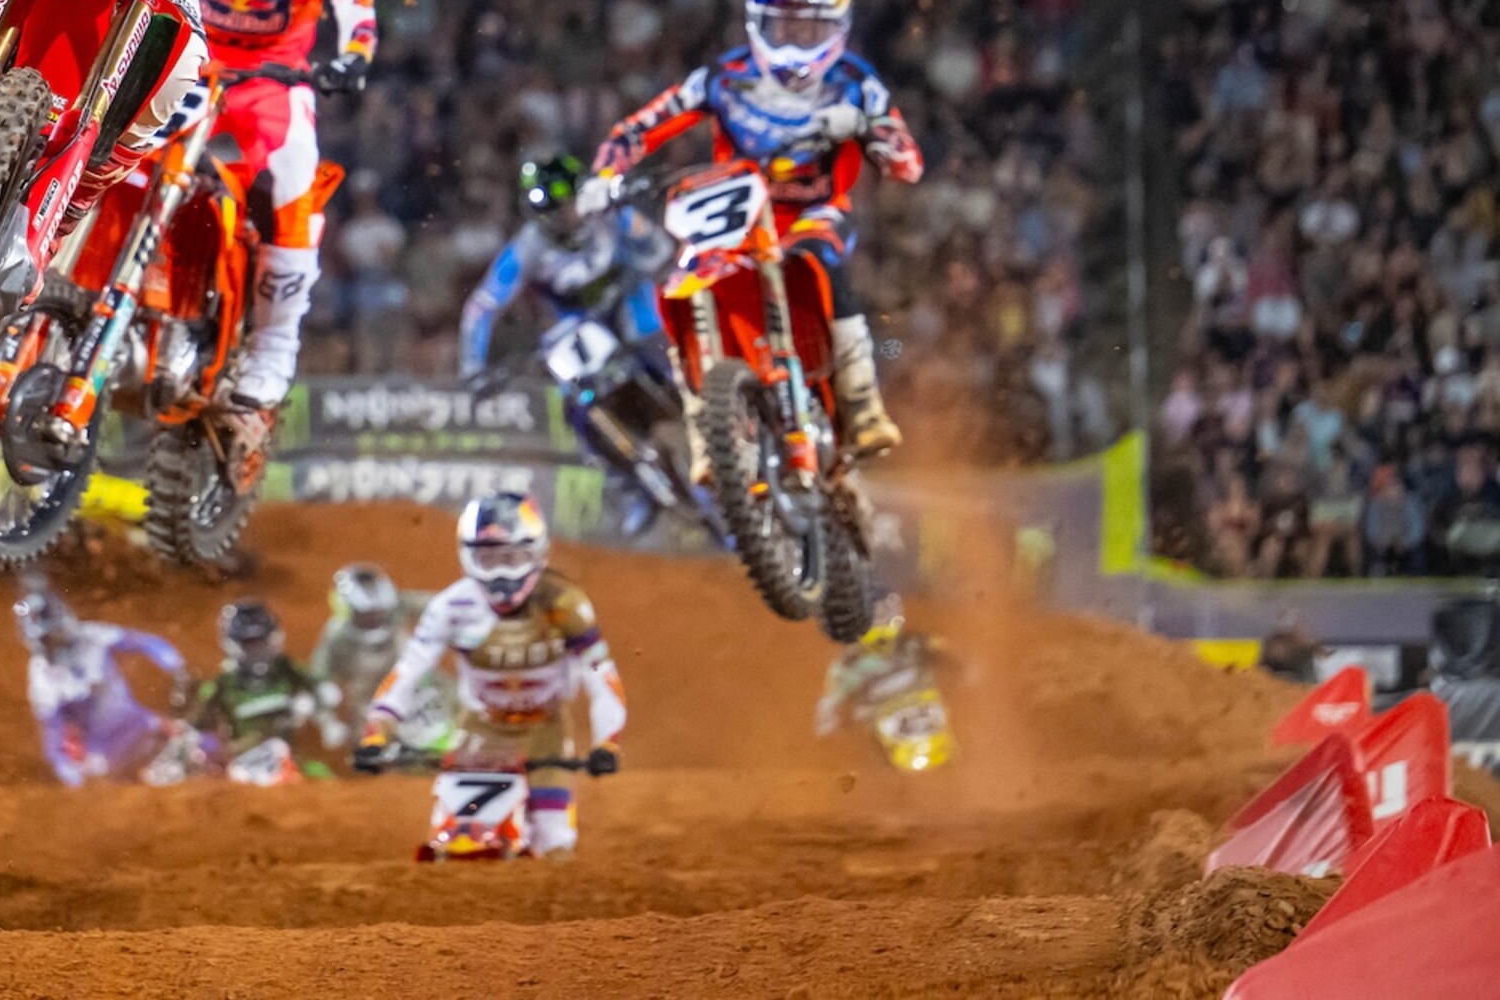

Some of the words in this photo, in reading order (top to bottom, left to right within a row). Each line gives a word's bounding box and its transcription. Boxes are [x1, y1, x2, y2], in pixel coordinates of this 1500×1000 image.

[40, 159, 84, 255] DUNLOP
[686, 184, 752, 243] 3
[456, 779, 514, 817] 7
